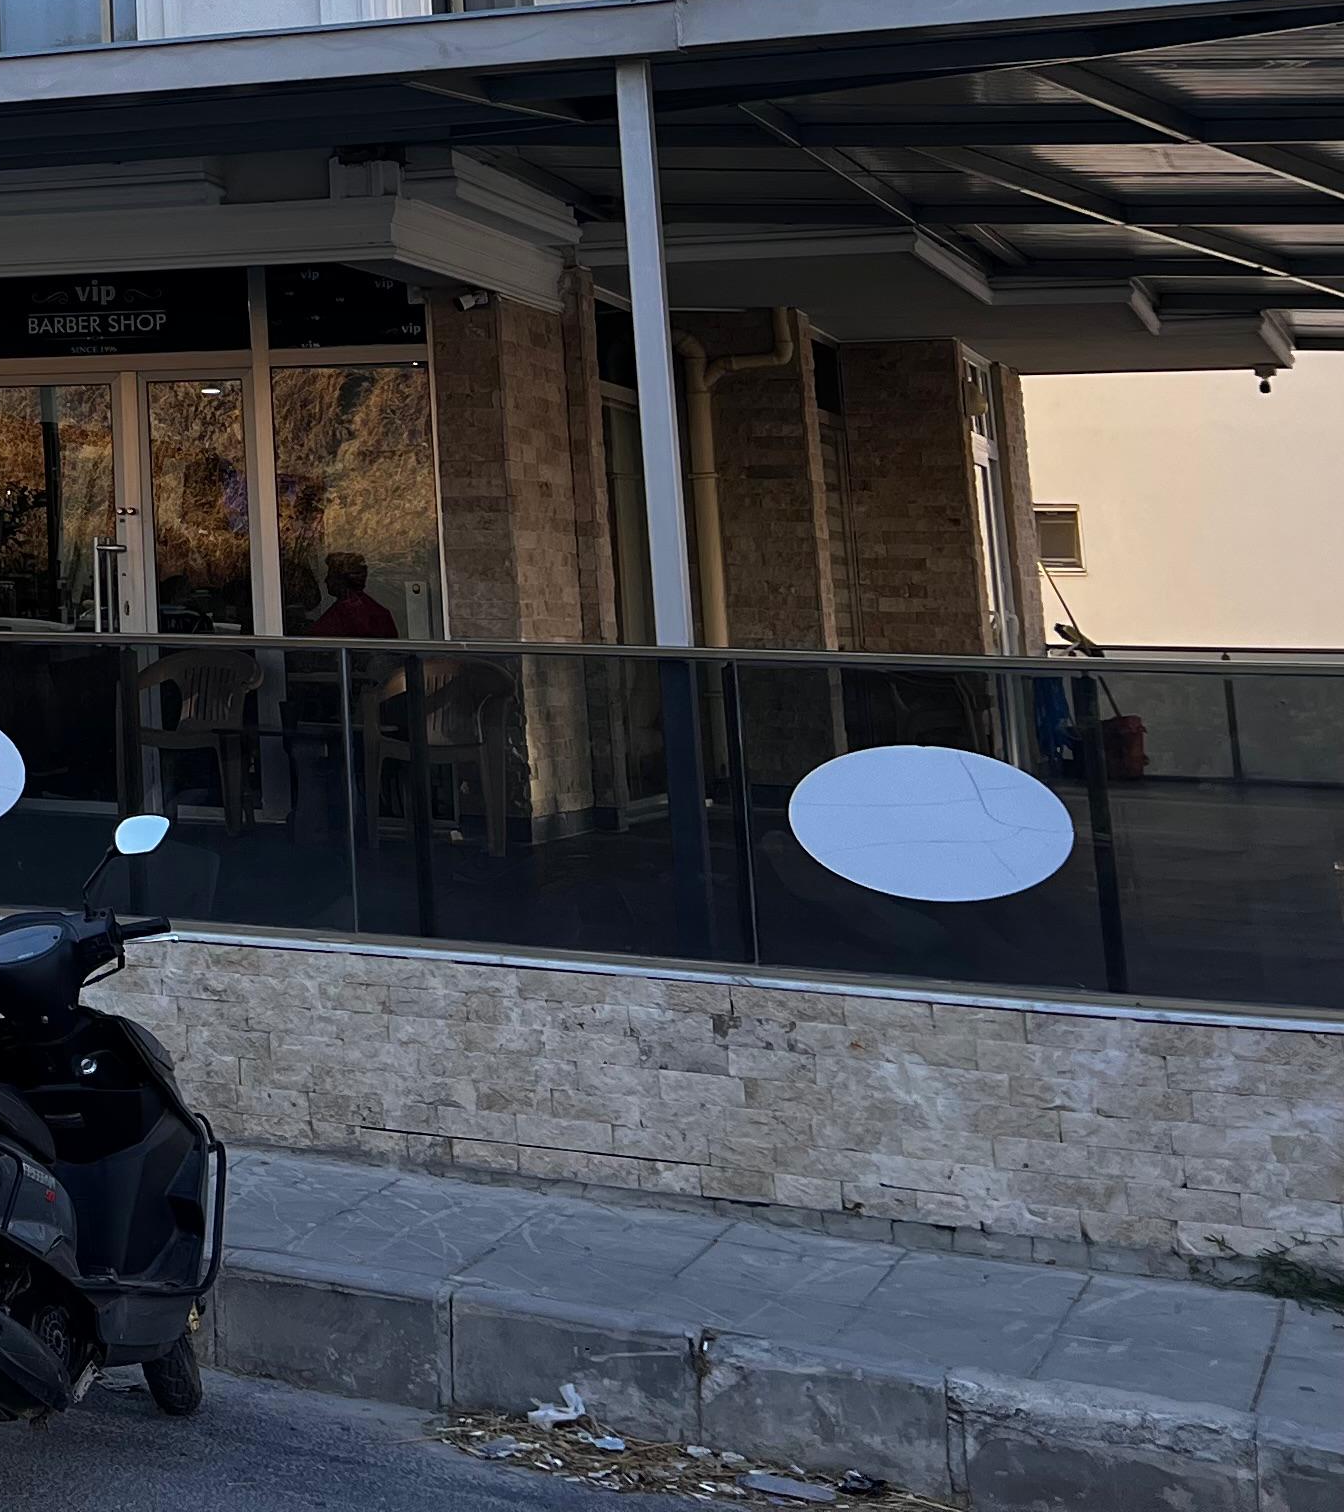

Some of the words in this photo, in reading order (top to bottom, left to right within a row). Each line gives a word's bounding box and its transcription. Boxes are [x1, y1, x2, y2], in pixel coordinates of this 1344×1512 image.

[75, 280, 116, 305] vip
[28, 316, 102, 334] BARBER
[108, 314, 167, 333] SHOP
[401, 323, 421, 335] vip
[71, 346, 97, 354] SINCE
